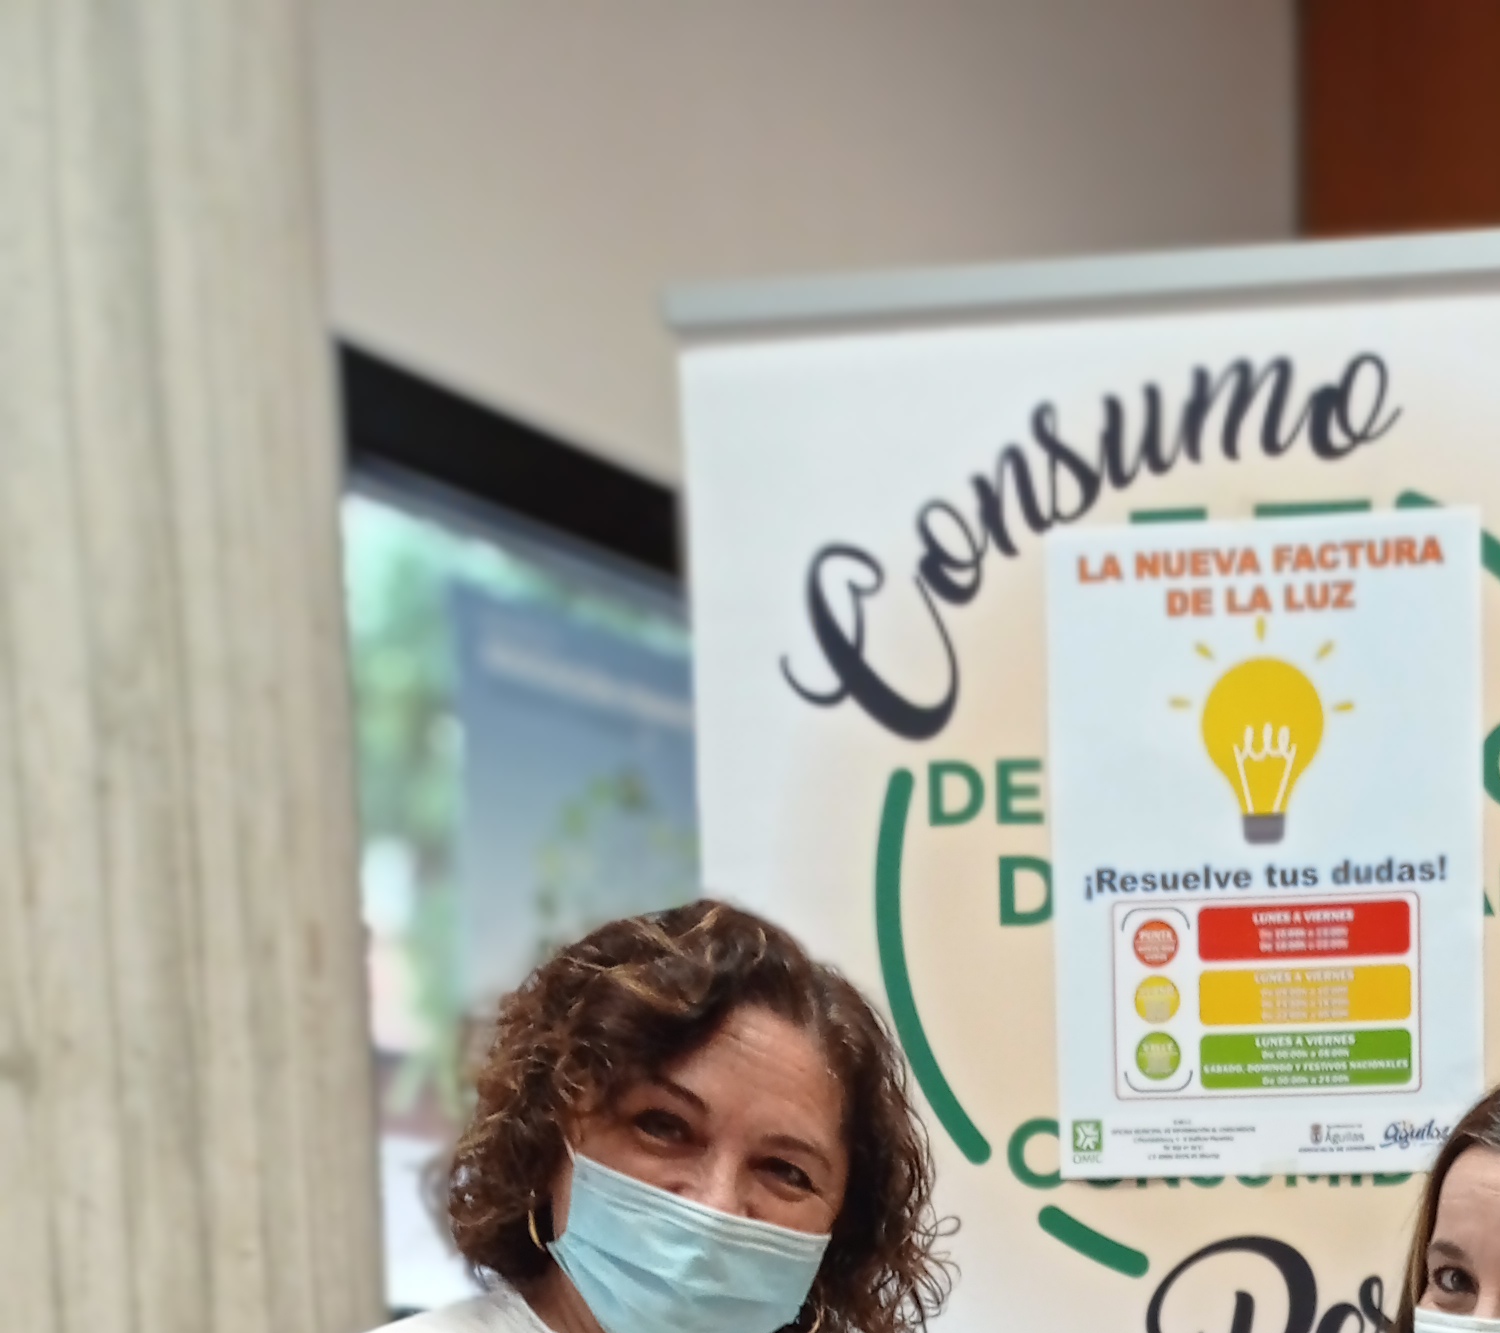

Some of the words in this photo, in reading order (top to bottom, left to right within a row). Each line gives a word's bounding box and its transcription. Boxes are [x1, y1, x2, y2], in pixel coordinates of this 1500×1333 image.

[782, 350, 1403, 740] Consumo
[1077, 554, 1123, 583] LA
[1135, 547, 1261, 580] NUEVA
[1273, 536, 1444, 573] FACTURA
[1166, 588, 1212, 617] DE
[1226, 585, 1272, 614] LA
[1284, 580, 1355, 612] LUZ
[1086, 865, 1252, 900] ¡Resuelve
[1264, 858, 1319, 891] tus
[1331, 855, 1446, 885] dudas!
[1253, 911, 1291, 924] LUNES
[1303, 909, 1354, 923] VIERNES
[1306, 1034, 1356, 1046] VIERNES
